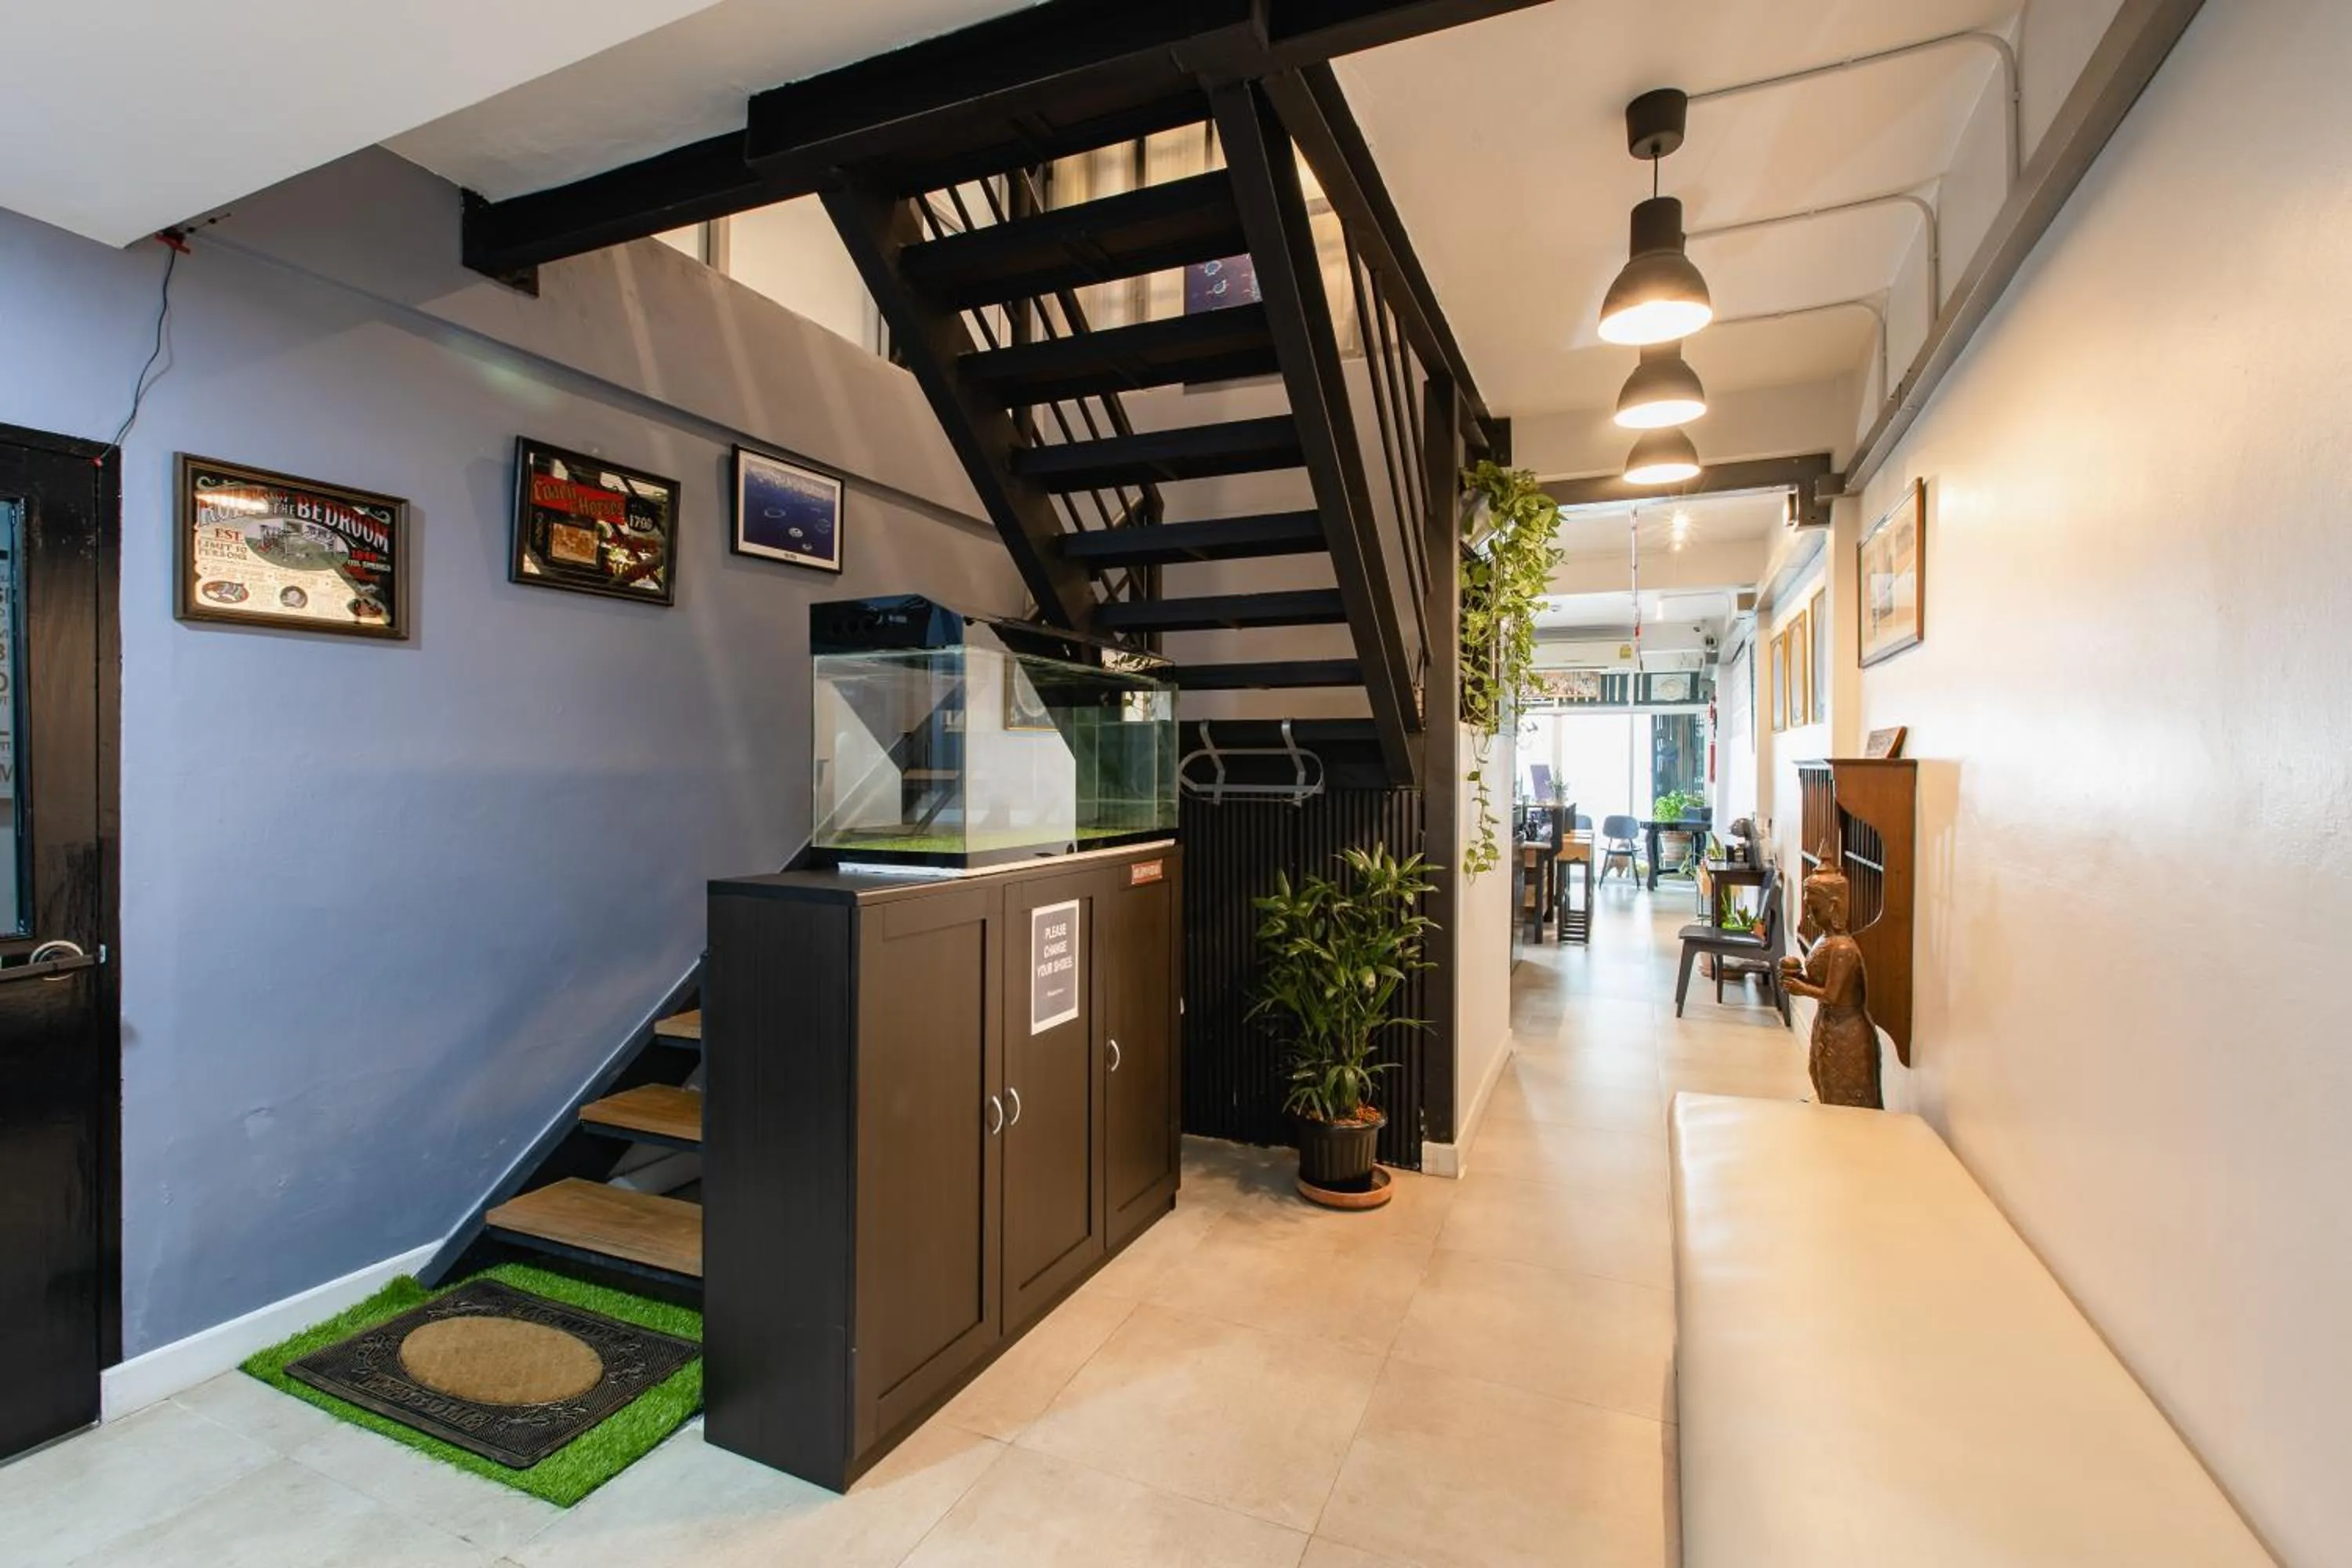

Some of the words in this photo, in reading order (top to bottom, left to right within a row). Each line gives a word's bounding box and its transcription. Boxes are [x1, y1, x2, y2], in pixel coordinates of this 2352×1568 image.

[296, 492, 390, 554] BEDROOM
[1045, 923, 1067, 939] PLEASE
[1043, 939, 1067, 959] CHANGE
[1036, 961, 1053, 979] YOUR
[1053, 954, 1073, 973] SHOES
